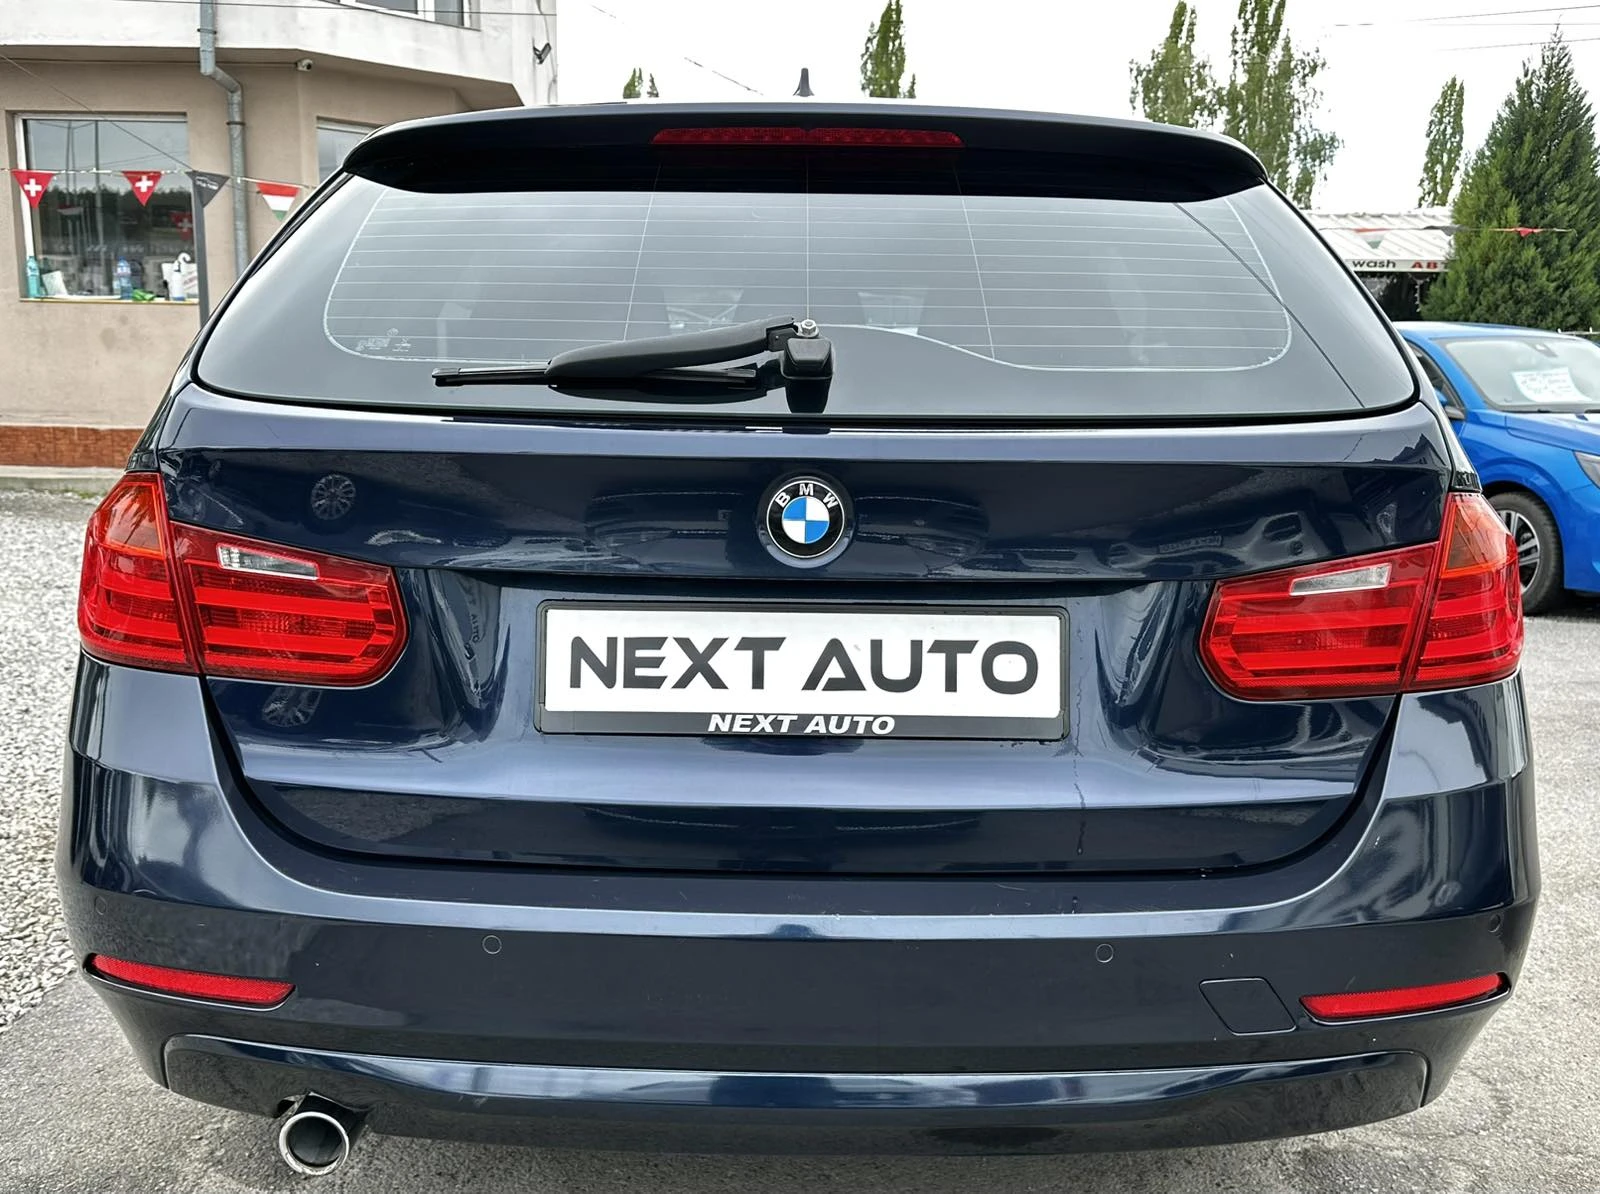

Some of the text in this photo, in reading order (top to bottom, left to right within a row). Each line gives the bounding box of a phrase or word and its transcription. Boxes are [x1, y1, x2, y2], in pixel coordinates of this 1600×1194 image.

[1352, 260, 1396, 269] wash
[775, 484, 838, 508] BMW
[570, 635, 1039, 695] NEXT AUTO
[708, 713, 895, 735] NEXT AUTO
